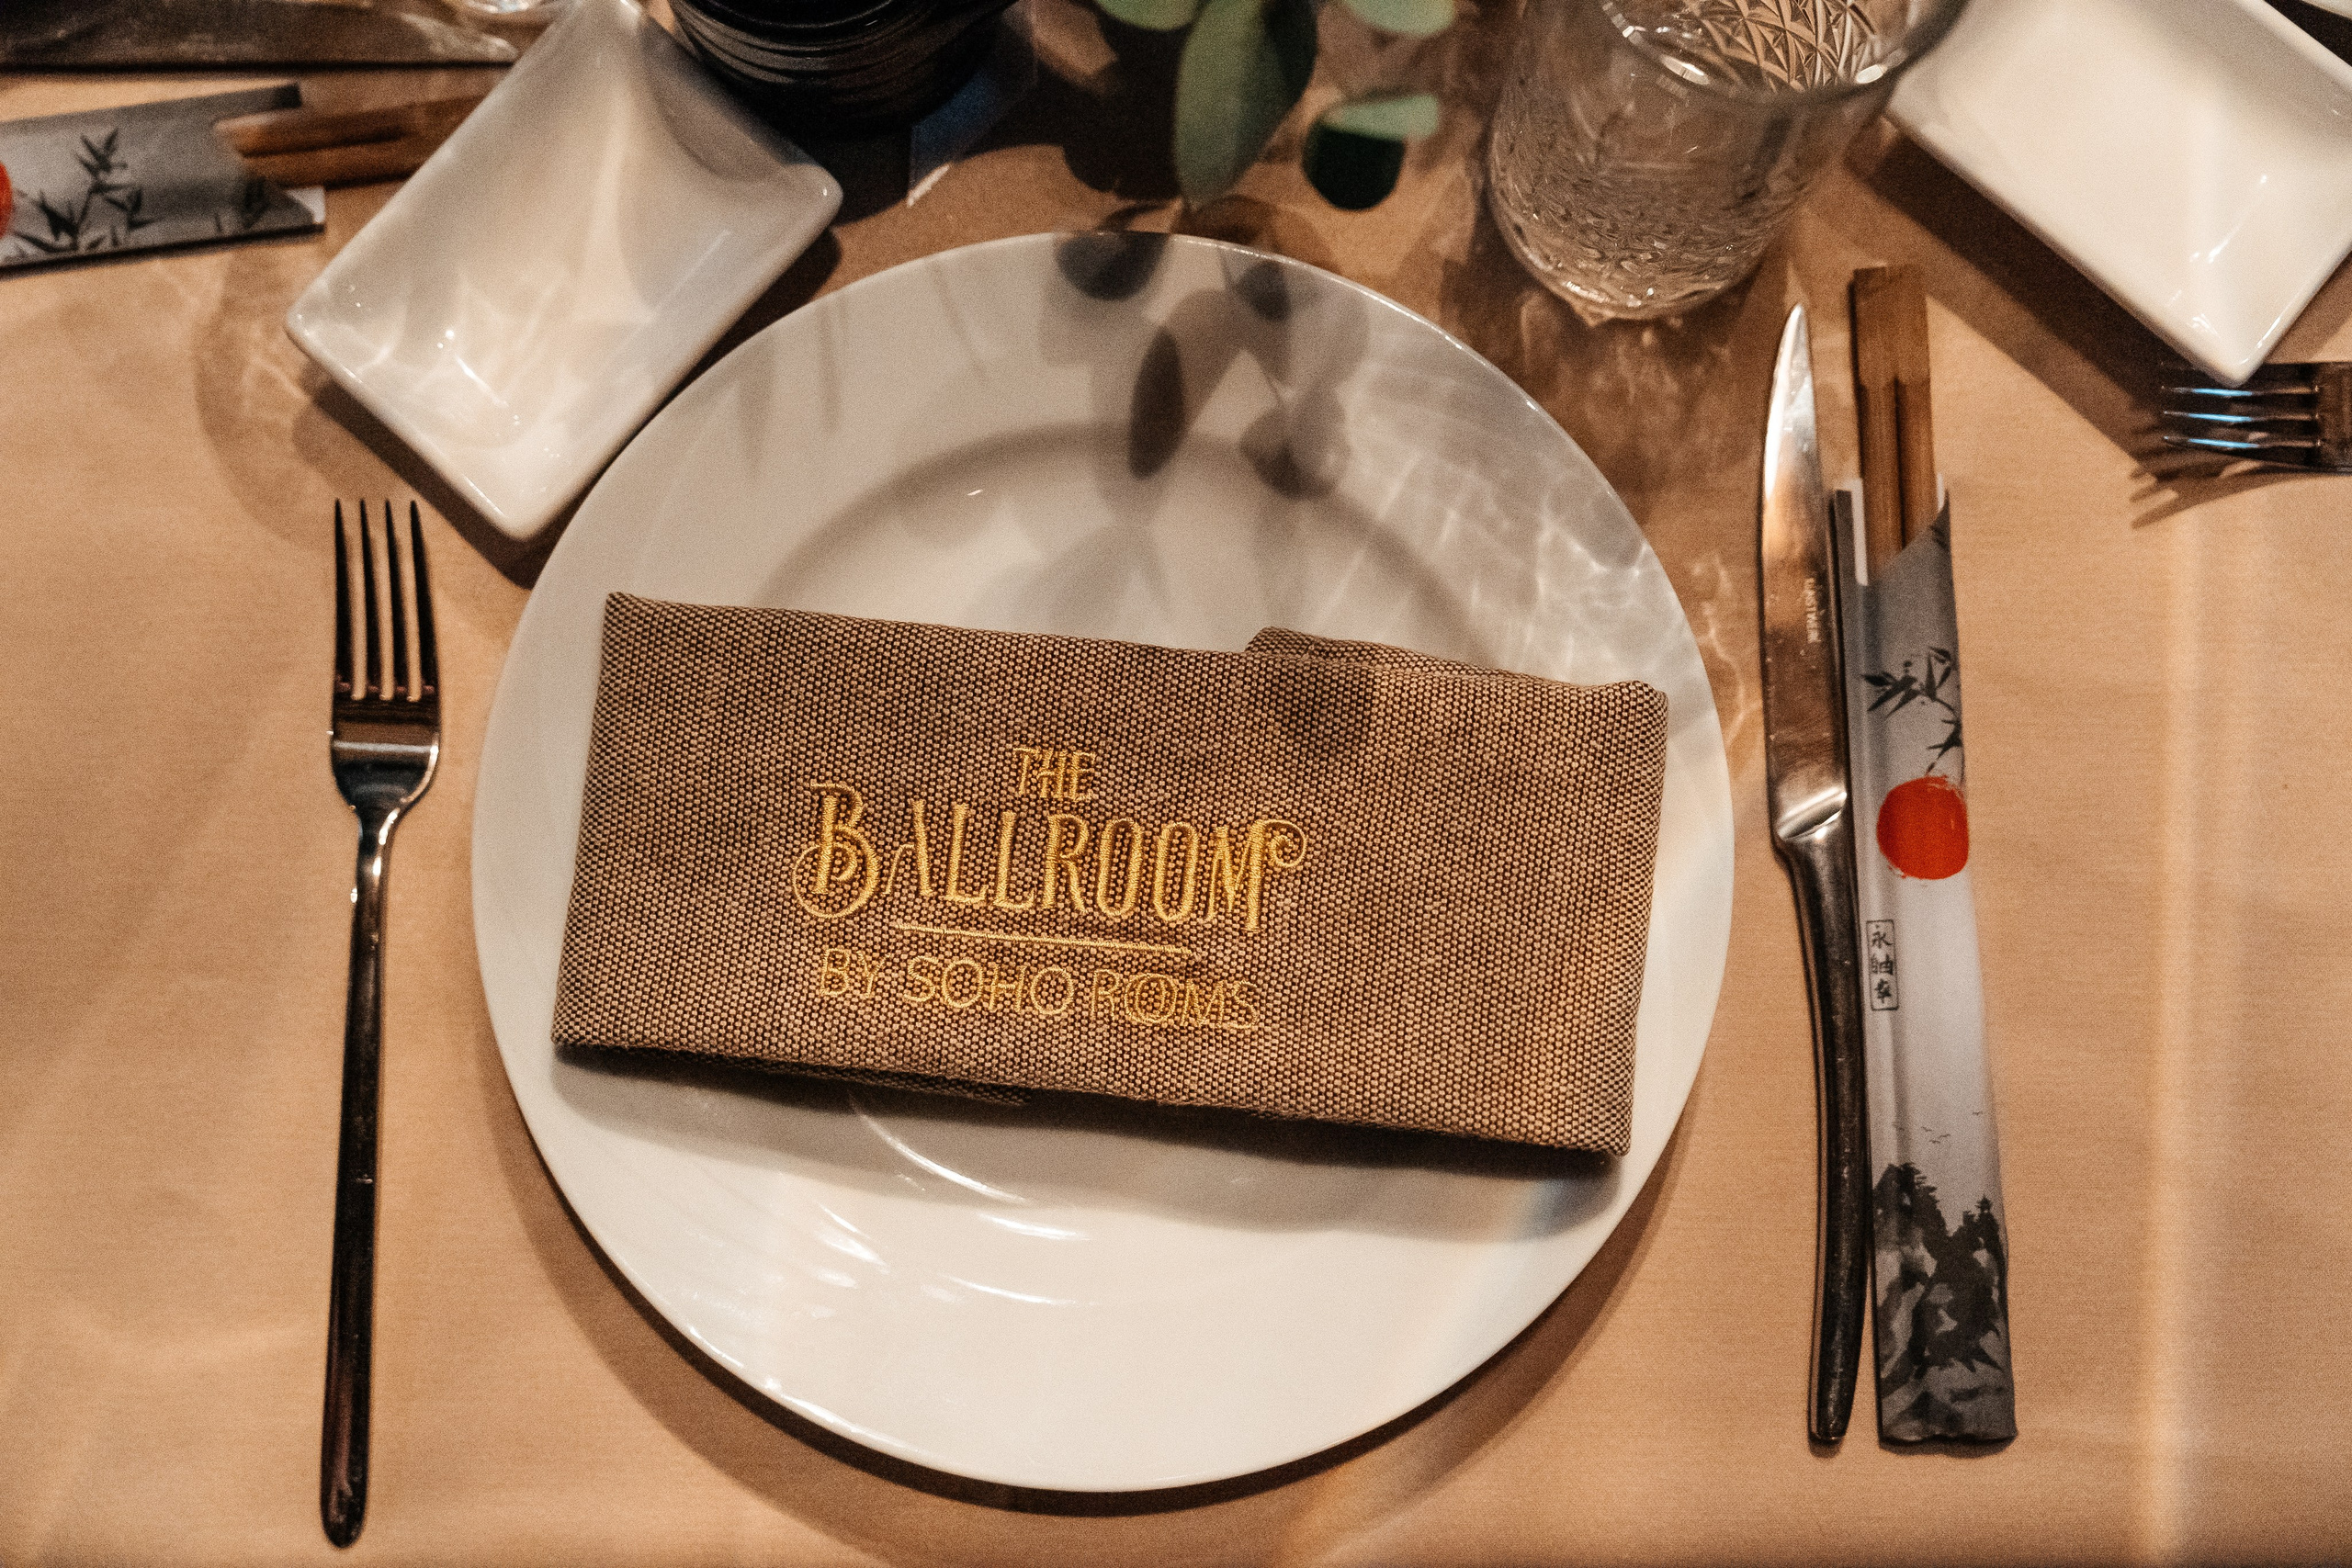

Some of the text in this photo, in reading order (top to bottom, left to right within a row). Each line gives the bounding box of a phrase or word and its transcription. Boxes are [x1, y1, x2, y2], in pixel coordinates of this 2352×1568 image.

[1012, 747, 1097, 802] THE
[793, 782, 1308, 933] BALLROOM
[820, 947, 893, 998] BY
[903, 955, 1074, 1015] SOHO
